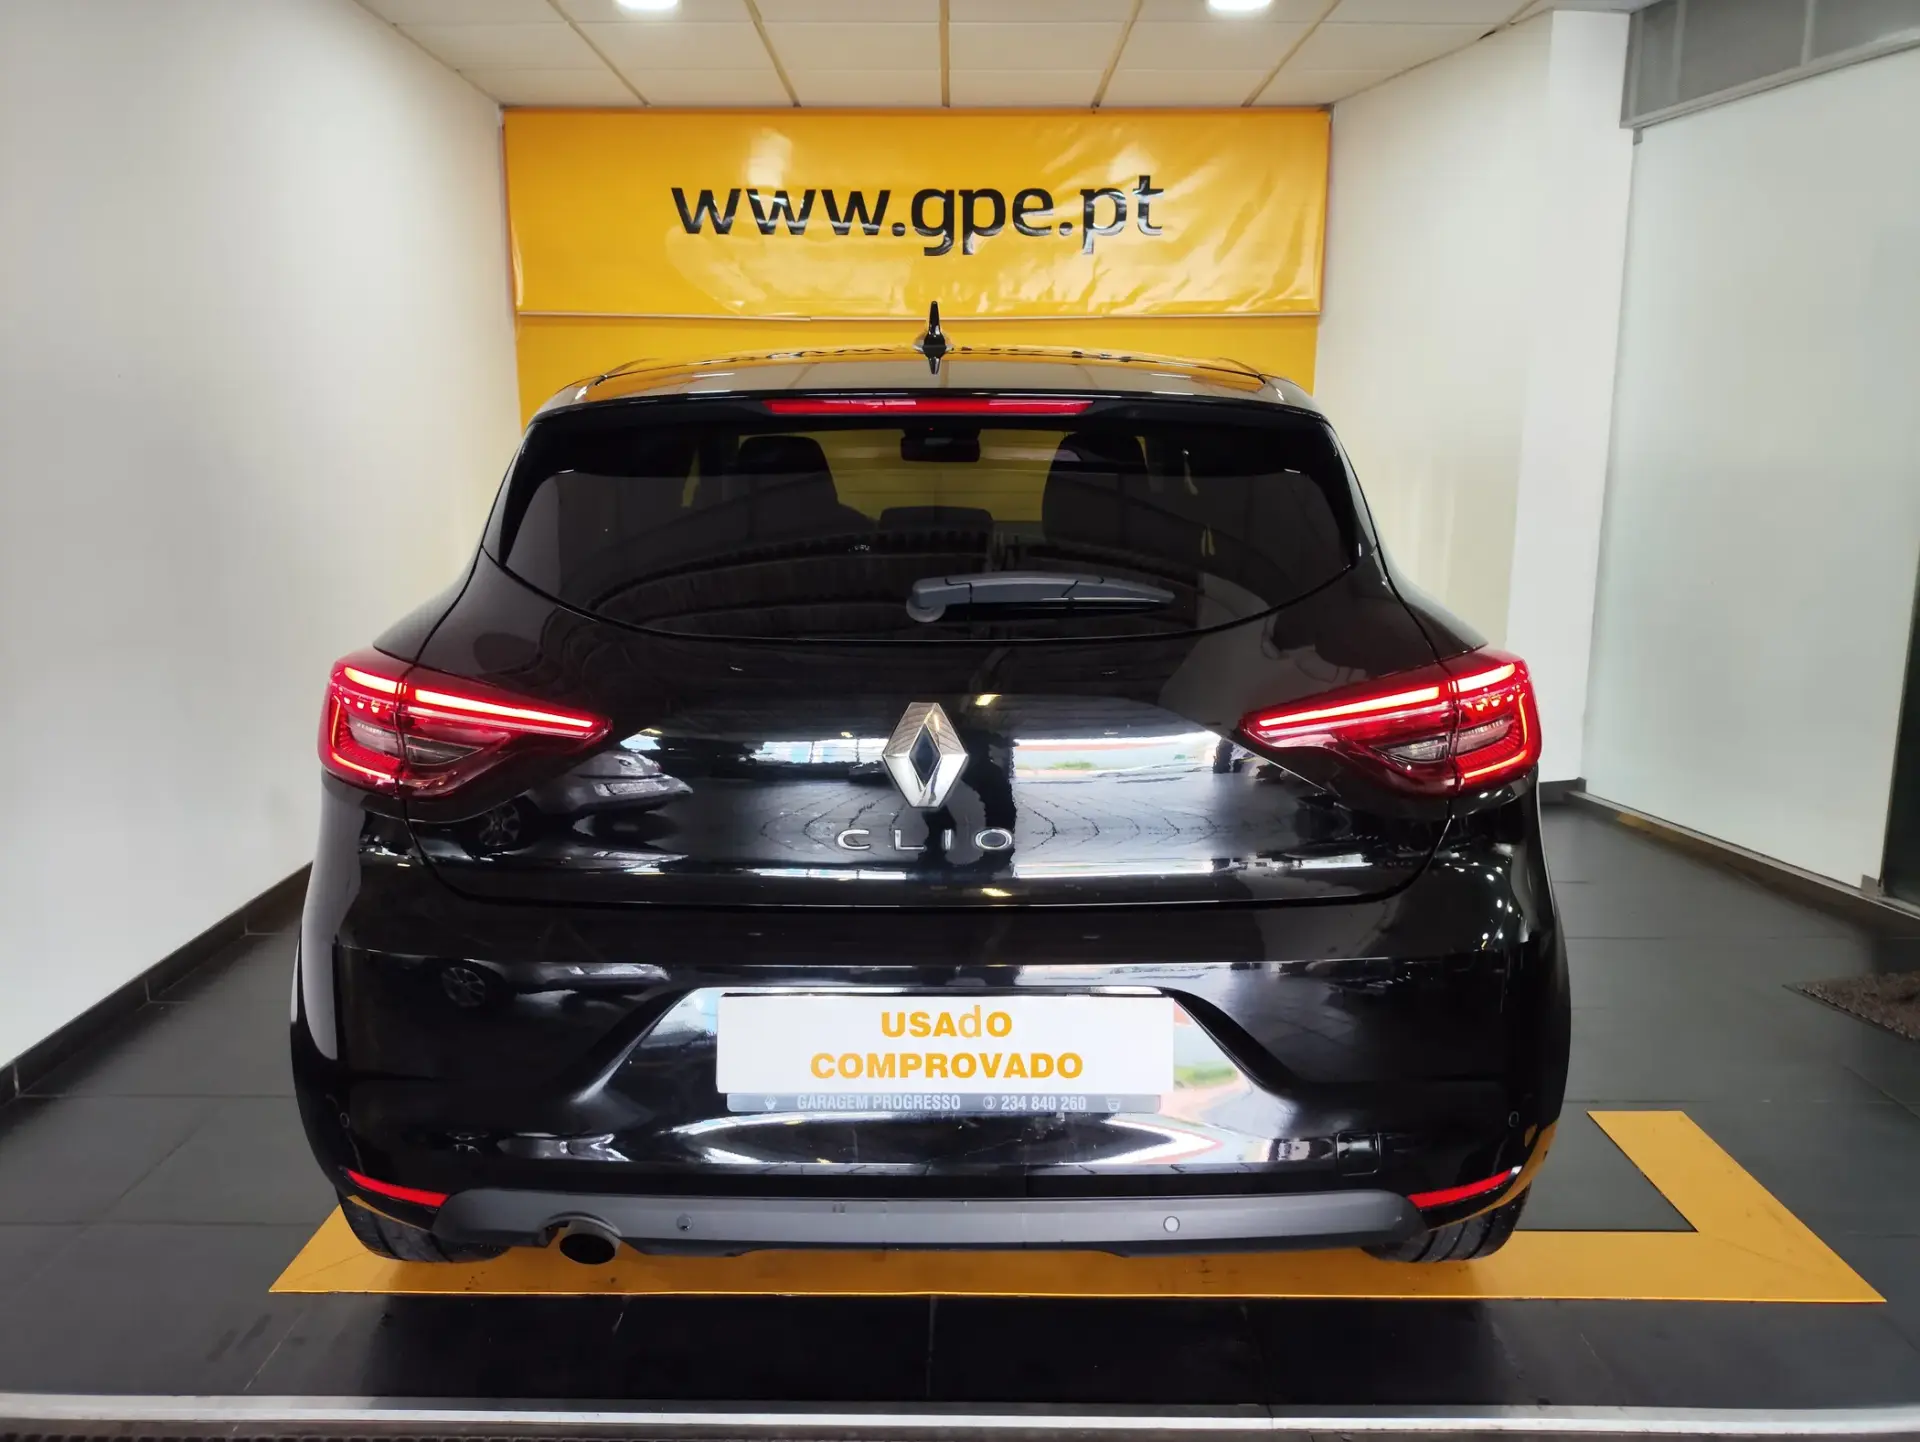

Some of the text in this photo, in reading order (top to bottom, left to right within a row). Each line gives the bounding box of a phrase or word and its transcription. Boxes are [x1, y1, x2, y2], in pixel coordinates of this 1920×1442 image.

[671, 175, 1164, 256] www.gpe.pt
[837, 828, 1013, 851] CLIO
[810, 1052, 1083, 1079] COMPROVADO
[797, 1095, 1087, 1111] GARAGEM PROGRESSO 234 840 260
